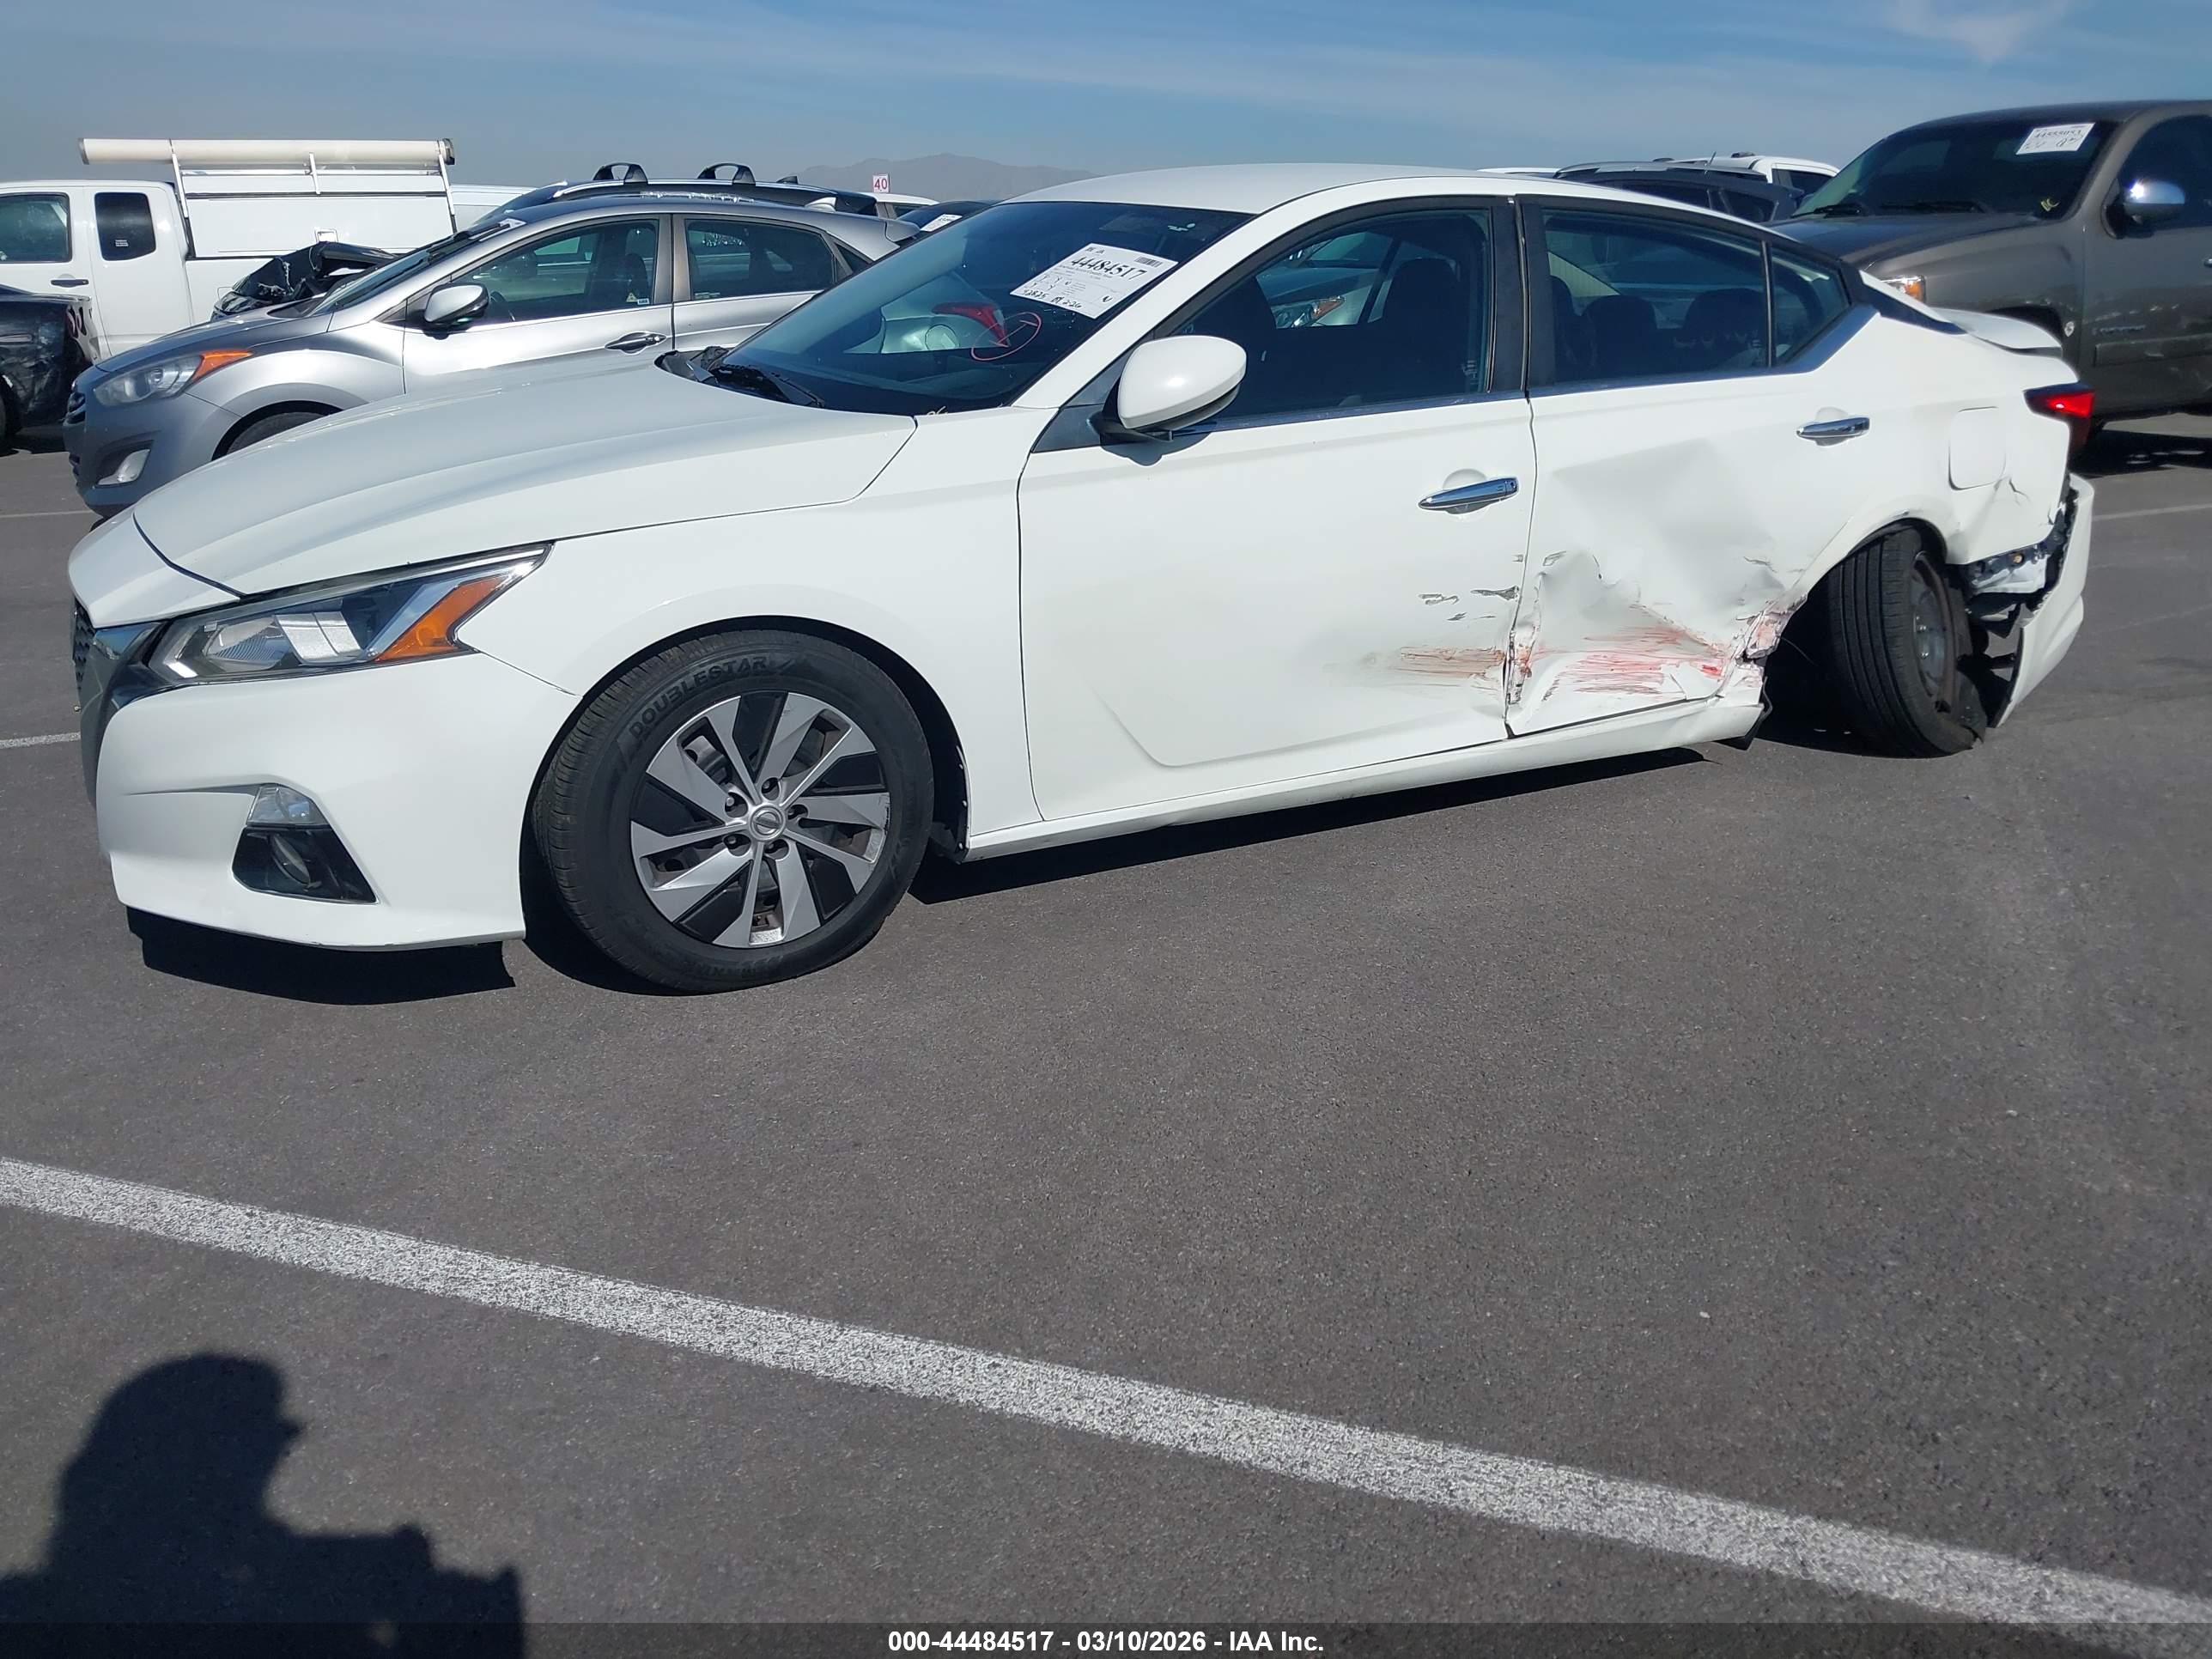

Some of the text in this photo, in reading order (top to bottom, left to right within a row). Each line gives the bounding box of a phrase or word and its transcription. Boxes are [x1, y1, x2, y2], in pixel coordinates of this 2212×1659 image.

[874, 178, 888, 190] 40
[1071, 257, 1147, 281] 44484517
[629, 655, 768, 739] DOUBLESTAR
